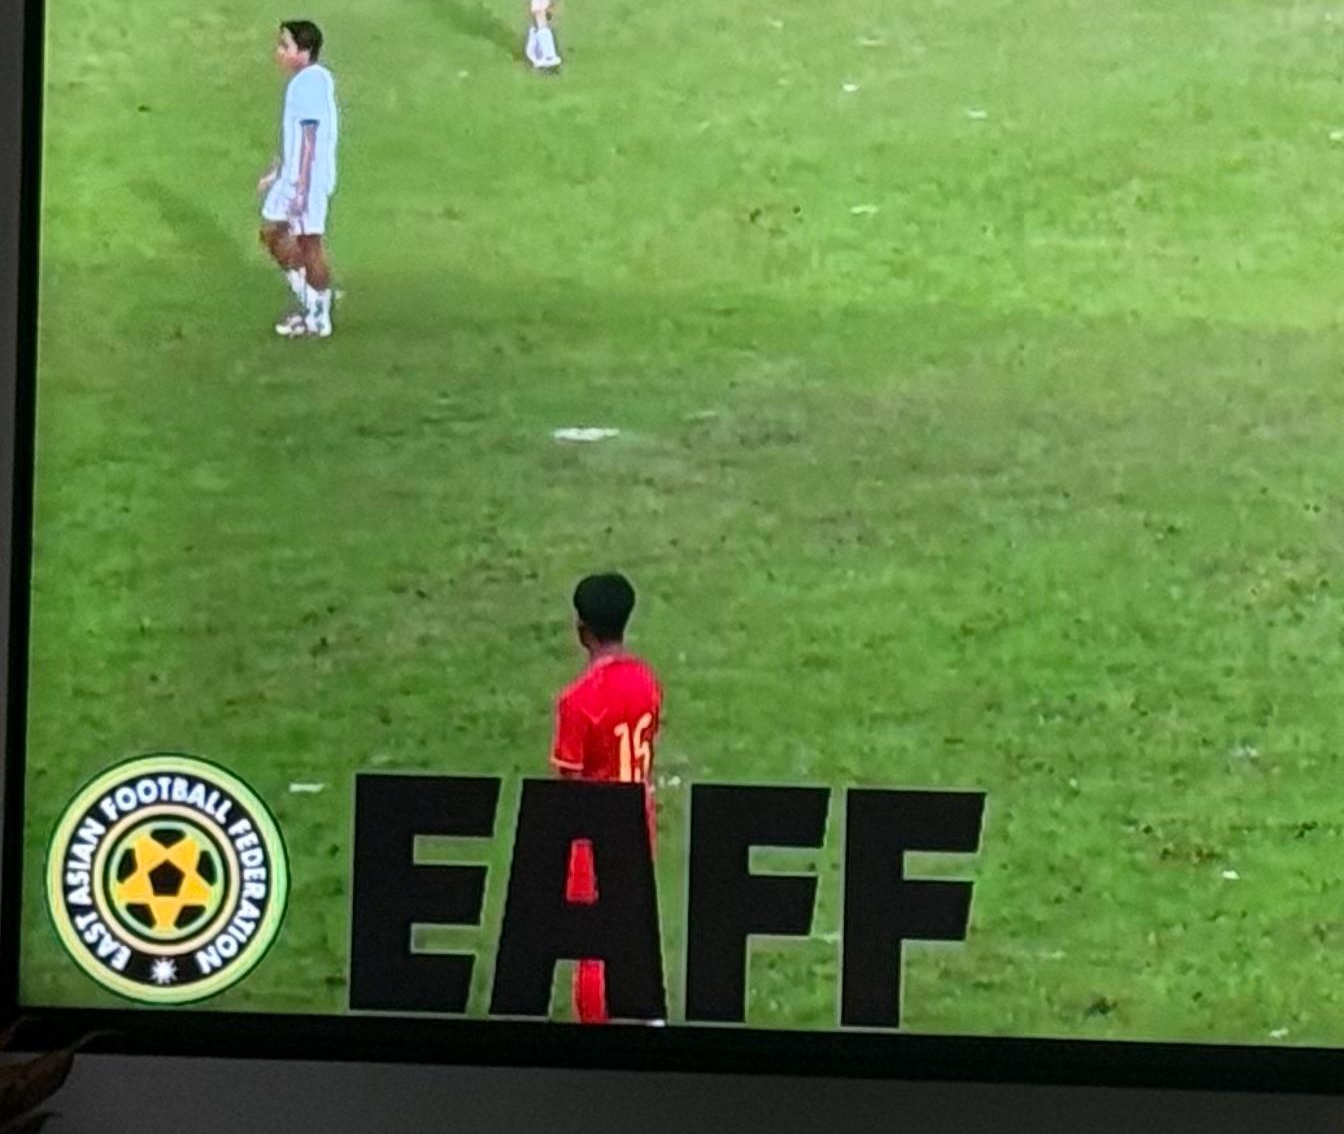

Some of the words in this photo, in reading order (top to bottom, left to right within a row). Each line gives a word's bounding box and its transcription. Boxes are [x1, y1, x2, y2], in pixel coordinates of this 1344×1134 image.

[100, 776, 233, 825] FOOTBALL
[65, 816, 107, 906] ASIAN
[194, 817, 268, 975] FEDERATION
[350, 773, 987, 1029] EAFF
[74, 911, 132, 972] EAST
